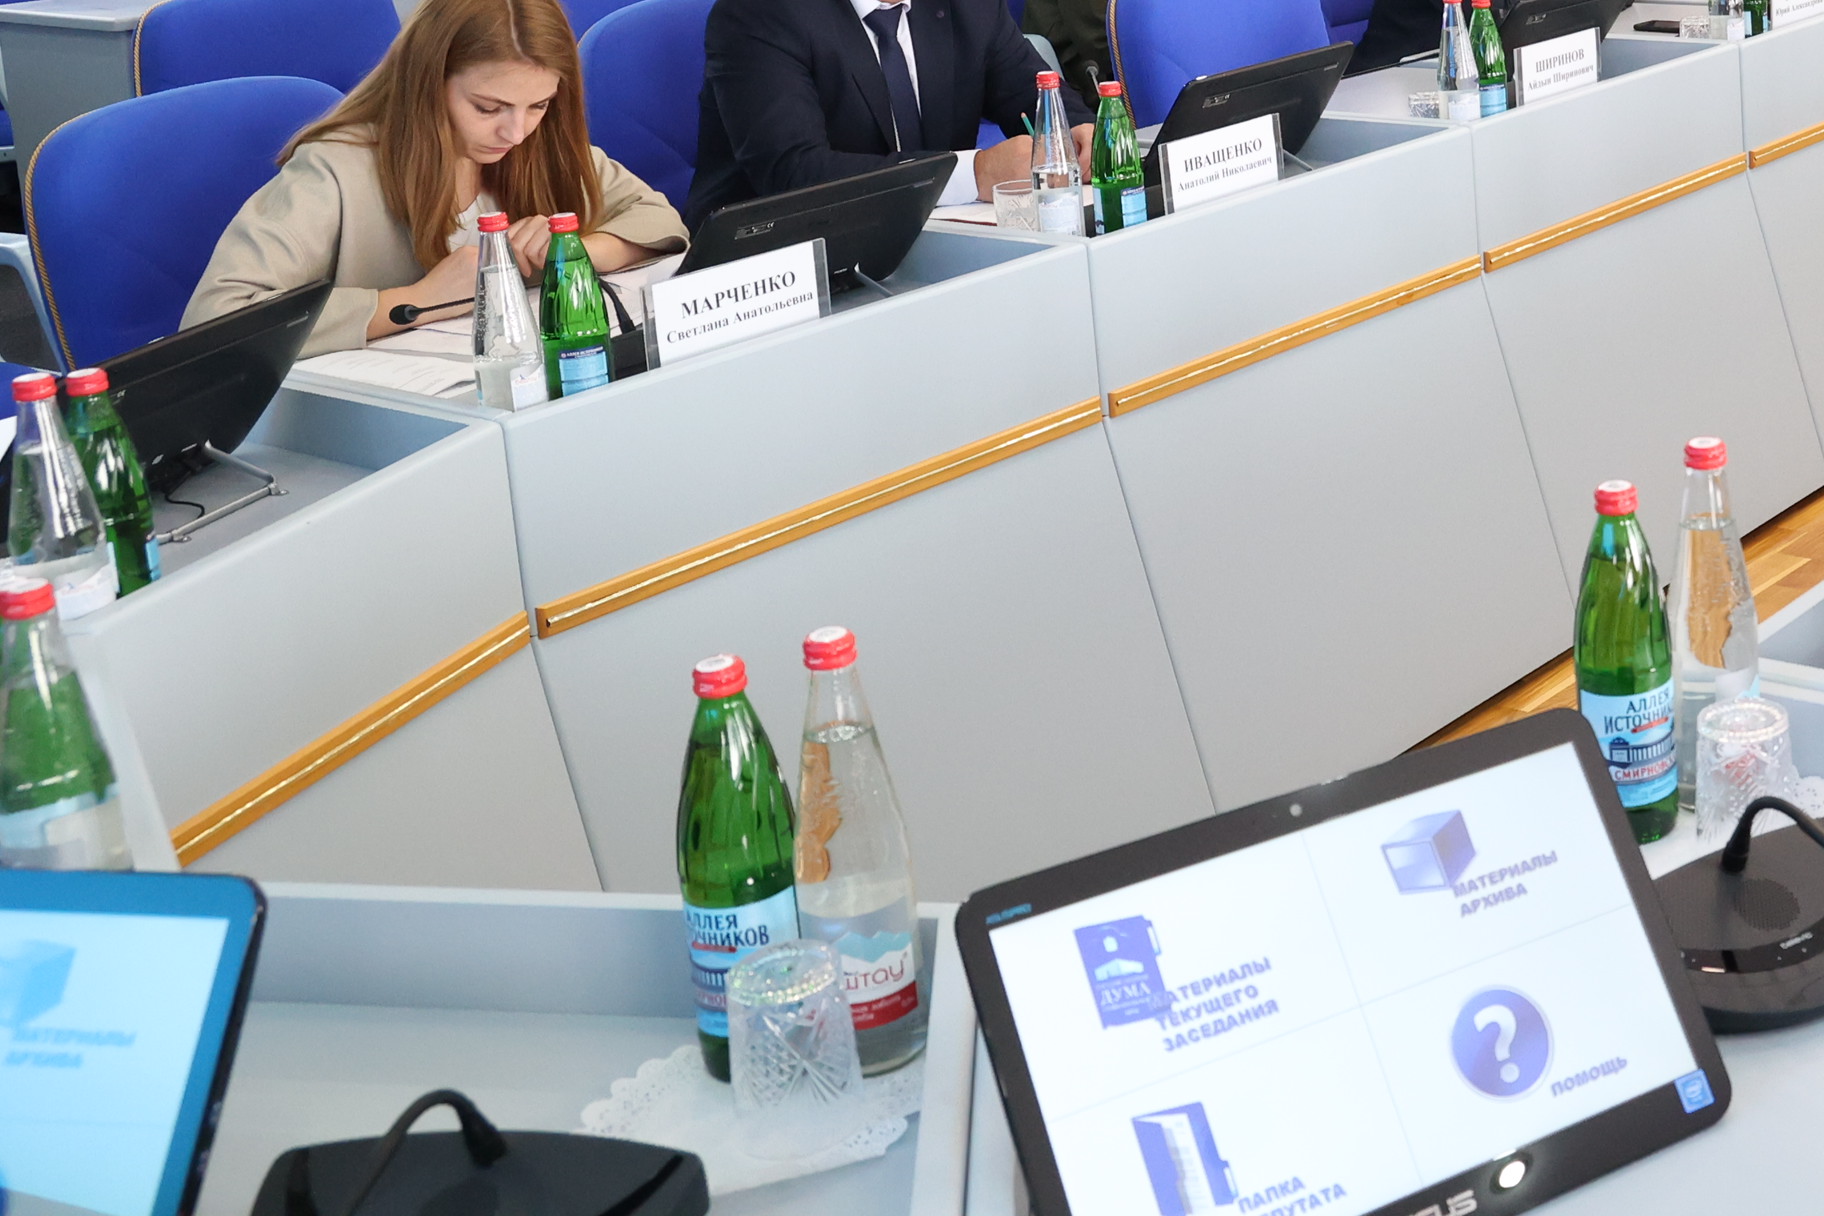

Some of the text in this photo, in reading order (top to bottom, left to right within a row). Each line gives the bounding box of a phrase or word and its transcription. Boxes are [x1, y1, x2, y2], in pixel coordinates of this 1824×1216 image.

[1535, 48, 1585, 73] ШИРИНОВ
[1177, 155, 1273, 193] Анатолий Николаевич
[1183, 137, 1263, 174] ИВАЩЕНКО
[681, 270, 797, 319] МАРЧЕНКО
[666, 290, 814, 344] Светлана Анатольевна
[1626, 687, 1670, 714] АЛЛЕЯ
[1452, 850, 1559, 898] МАТЕРИАЛЫ
[1459, 883, 1529, 918] АРХИВА
[692, 924, 770, 948] ЧНИКОВ
[1154, 984, 1260, 1031] ТЕКУЩЕГО
[1162, 998, 1280, 1052] ЗАСЕДАНИЯ
[1549, 1055, 1629, 1098] ПОМОЩЬ
[1237, 1175, 1307, 1214] ПАПКА
[1258, 1183, 1348, 1216] ПУТАТА
